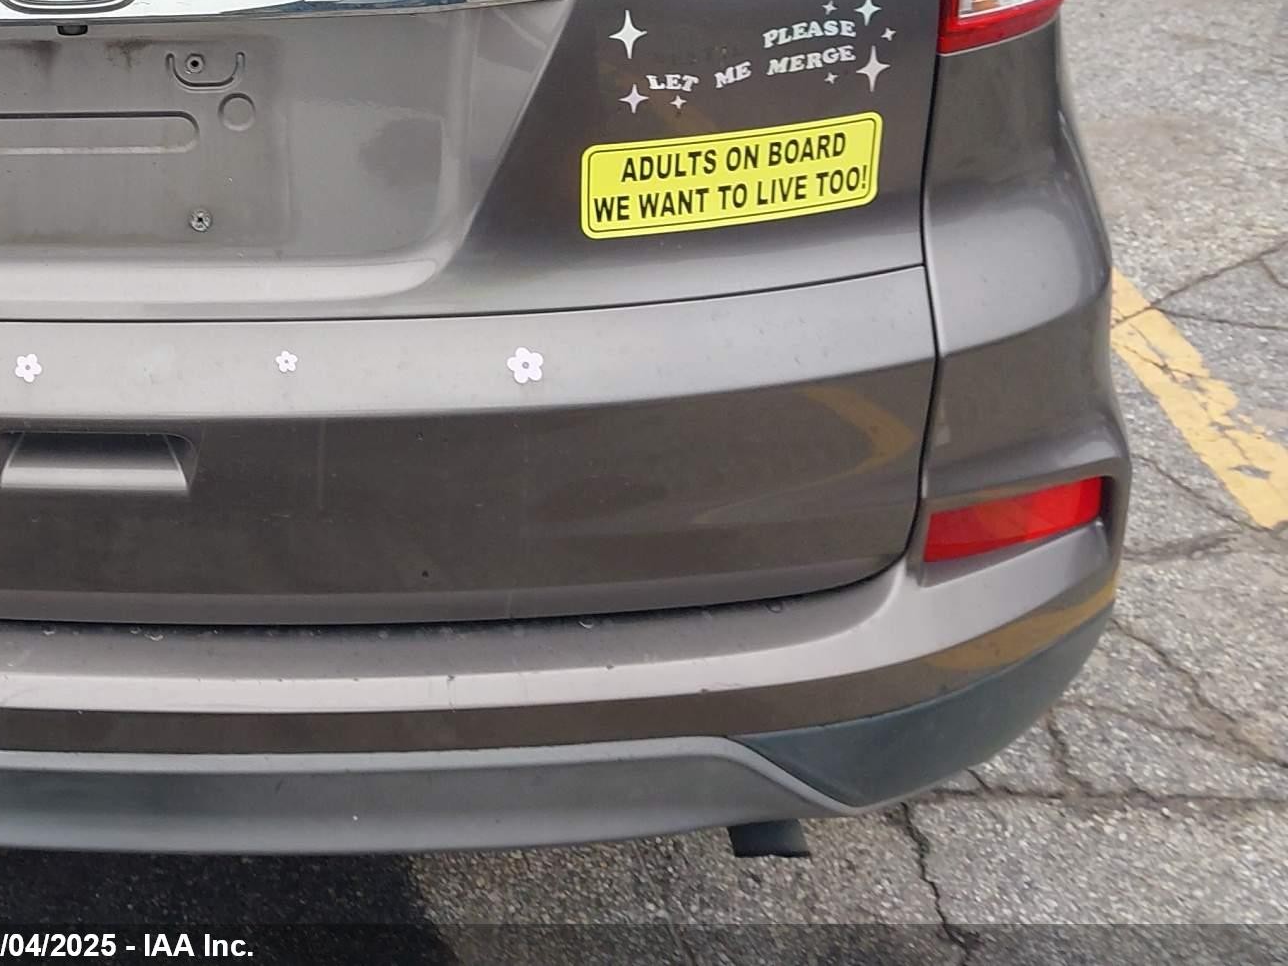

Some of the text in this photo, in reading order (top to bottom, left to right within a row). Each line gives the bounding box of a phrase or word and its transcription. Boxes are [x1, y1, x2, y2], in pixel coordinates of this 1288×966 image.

[762, 19, 857, 49] PLEASE
[646, 45, 856, 92] LET ME MERGE
[620, 131, 846, 183] ADULTS ON BOARD
[593, 164, 868, 223] WE WANT TO LIVE TOO!
